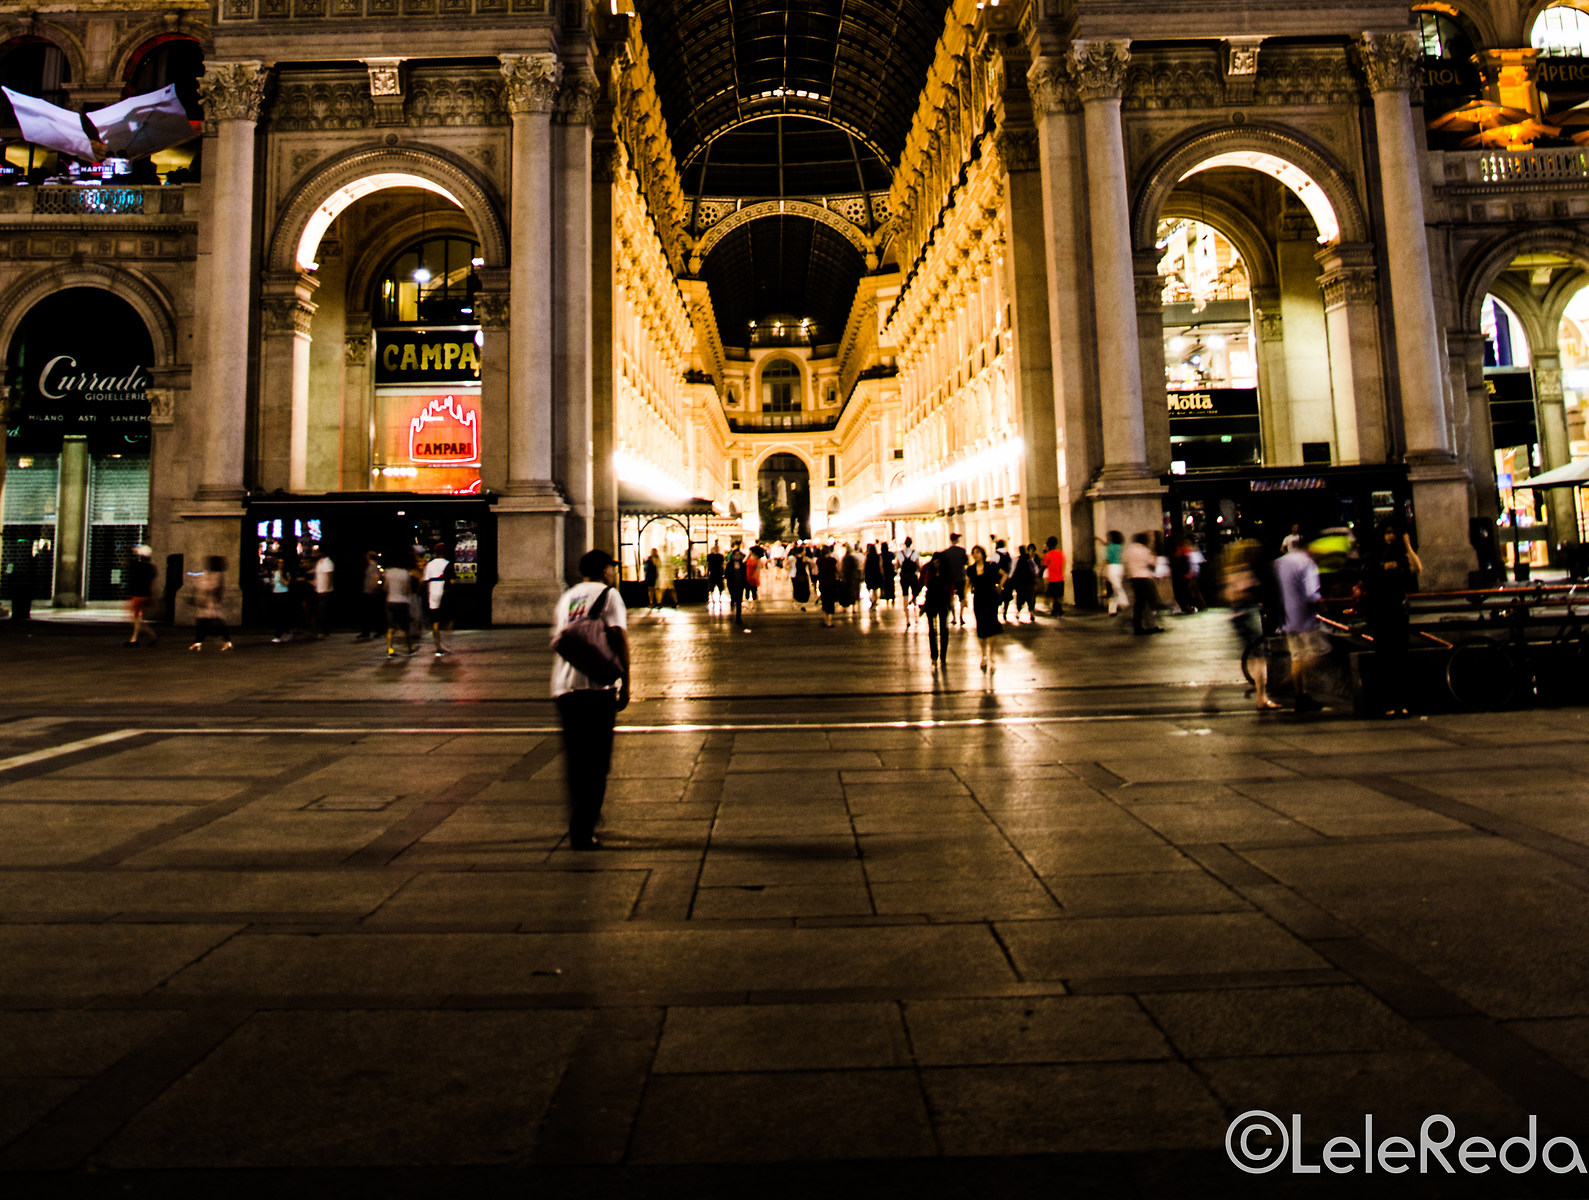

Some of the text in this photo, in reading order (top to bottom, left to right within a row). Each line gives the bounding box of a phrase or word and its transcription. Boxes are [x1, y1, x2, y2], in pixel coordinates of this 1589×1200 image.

[38, 355, 148, 399] Currado
[84, 392, 146, 401] GIOIELLERIE
[1167, 393, 1213, 410] Motta
[416, 443, 471, 455] CAMPARI
